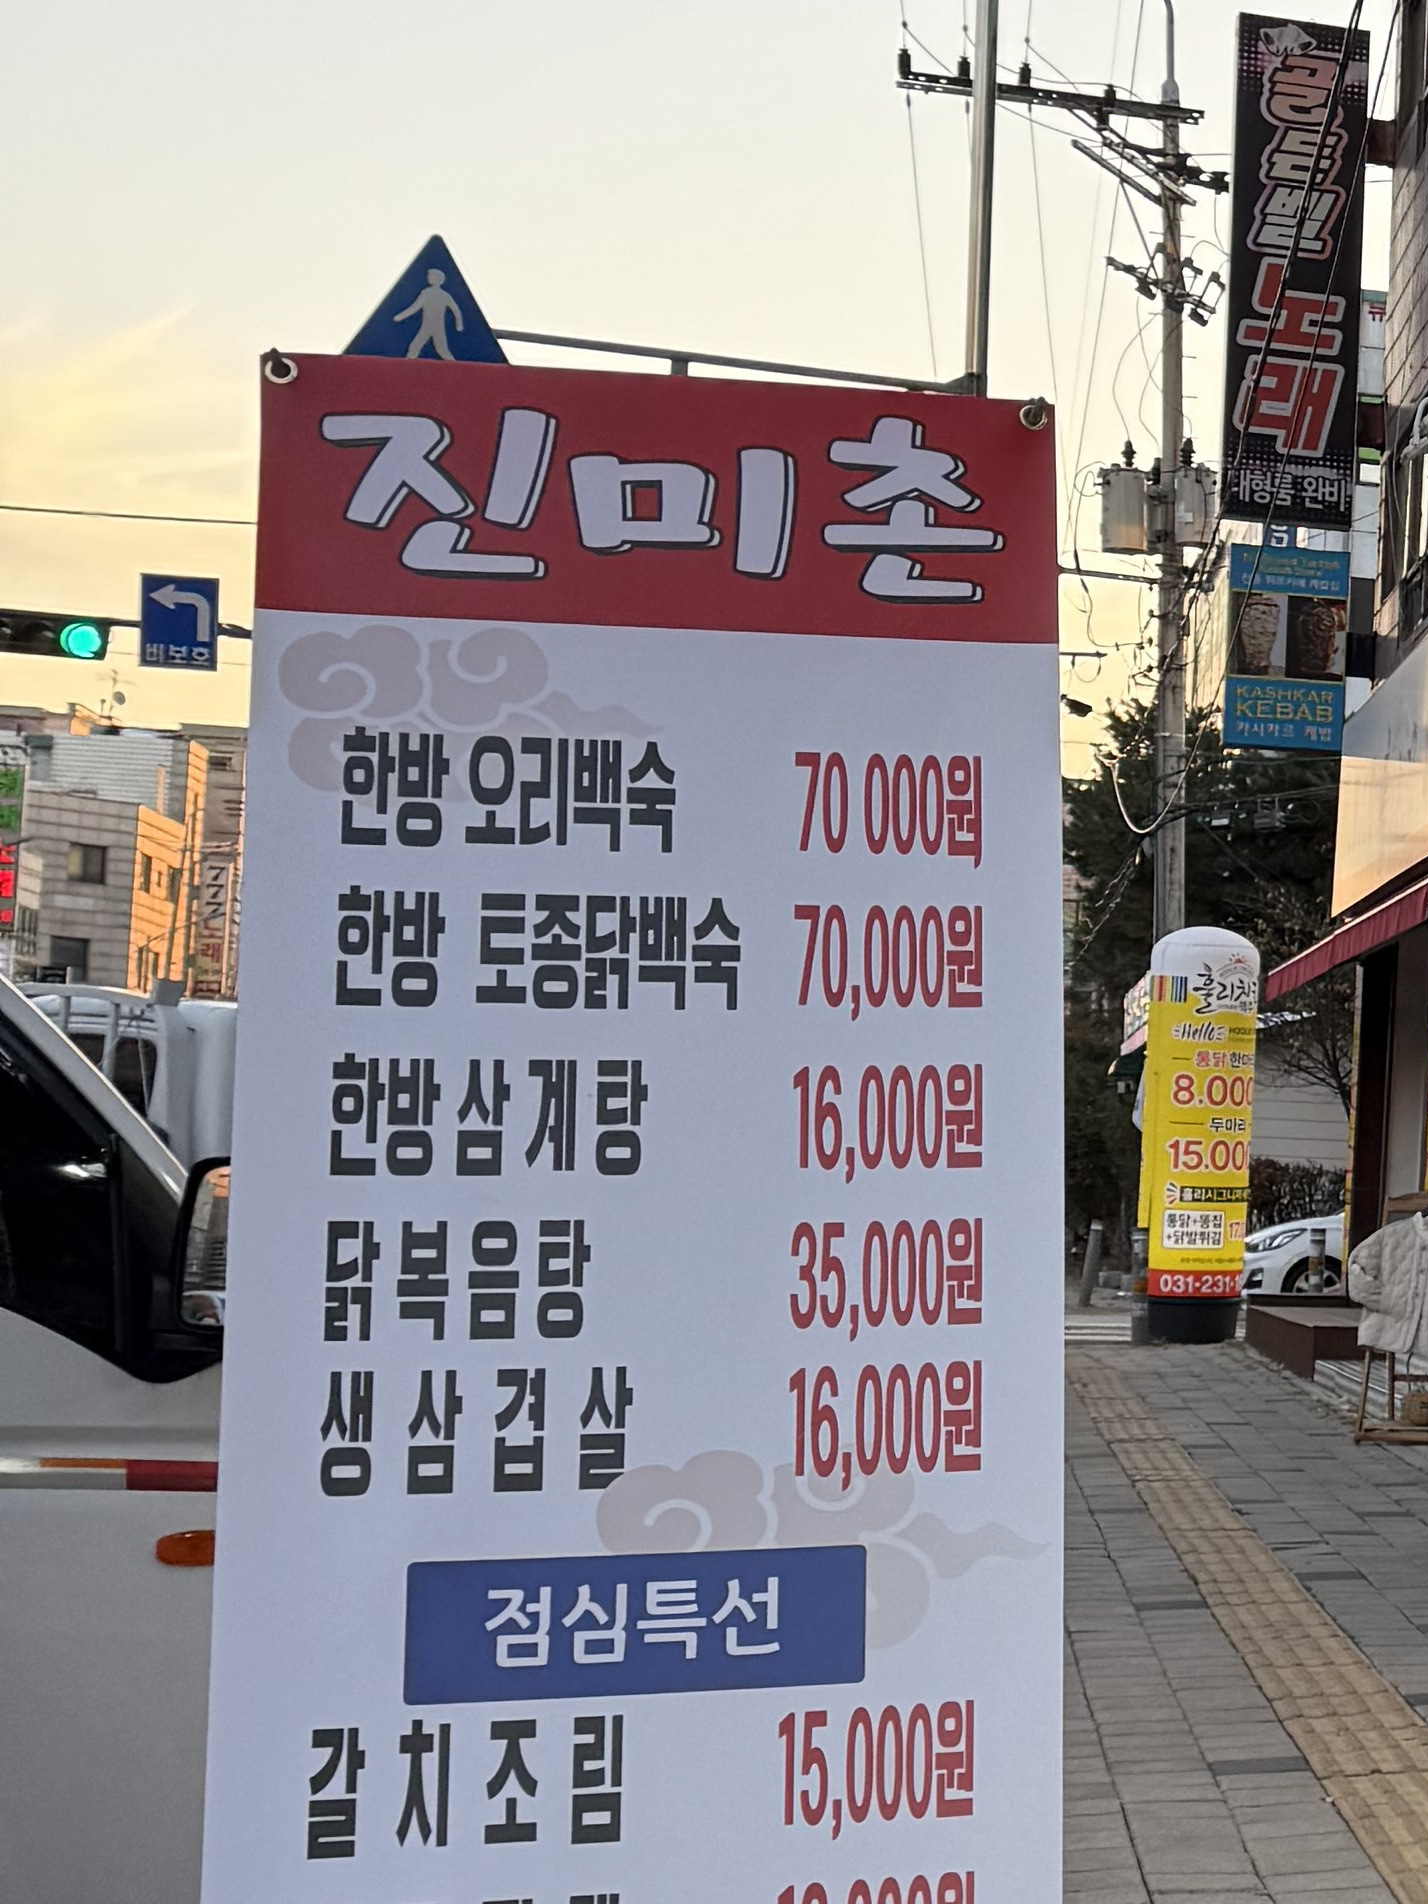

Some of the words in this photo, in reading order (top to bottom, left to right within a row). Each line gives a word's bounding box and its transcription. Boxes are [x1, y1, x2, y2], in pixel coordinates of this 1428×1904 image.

[1235, 257, 1346, 456] 노래
[319, 405, 1006, 604] 진미촌
[144, 643, 211, 666] 비보호
[1235, 685, 1334, 704] KASHKAR
[1235, 700, 1334, 723] KEBAB
[340, 725, 451, 851] 한방
[464, 731, 679, 856] 오리백숙
[334, 884, 448, 1010] 한방
[474, 892, 743, 1013] 토종닭백숙
[795, 902, 986, 1022] 70,000원
[328, 1052, 441, 1179] 한방
[456, 1057, 651, 1179] 삼계탕
[792, 1064, 986, 1186] 16,000원
[322, 1217, 593, 1343] 닭복음탕
[789, 1216, 986, 1343] 35,000원
[319, 1364, 636, 1497] 생삼겹살
[787, 1358, 986, 1490] 16,000원
[484, 1574, 786, 1670] 점심특선
[304, 1713, 626, 1861] 갈치조림
[777, 1698, 979, 1838] 15,000원
